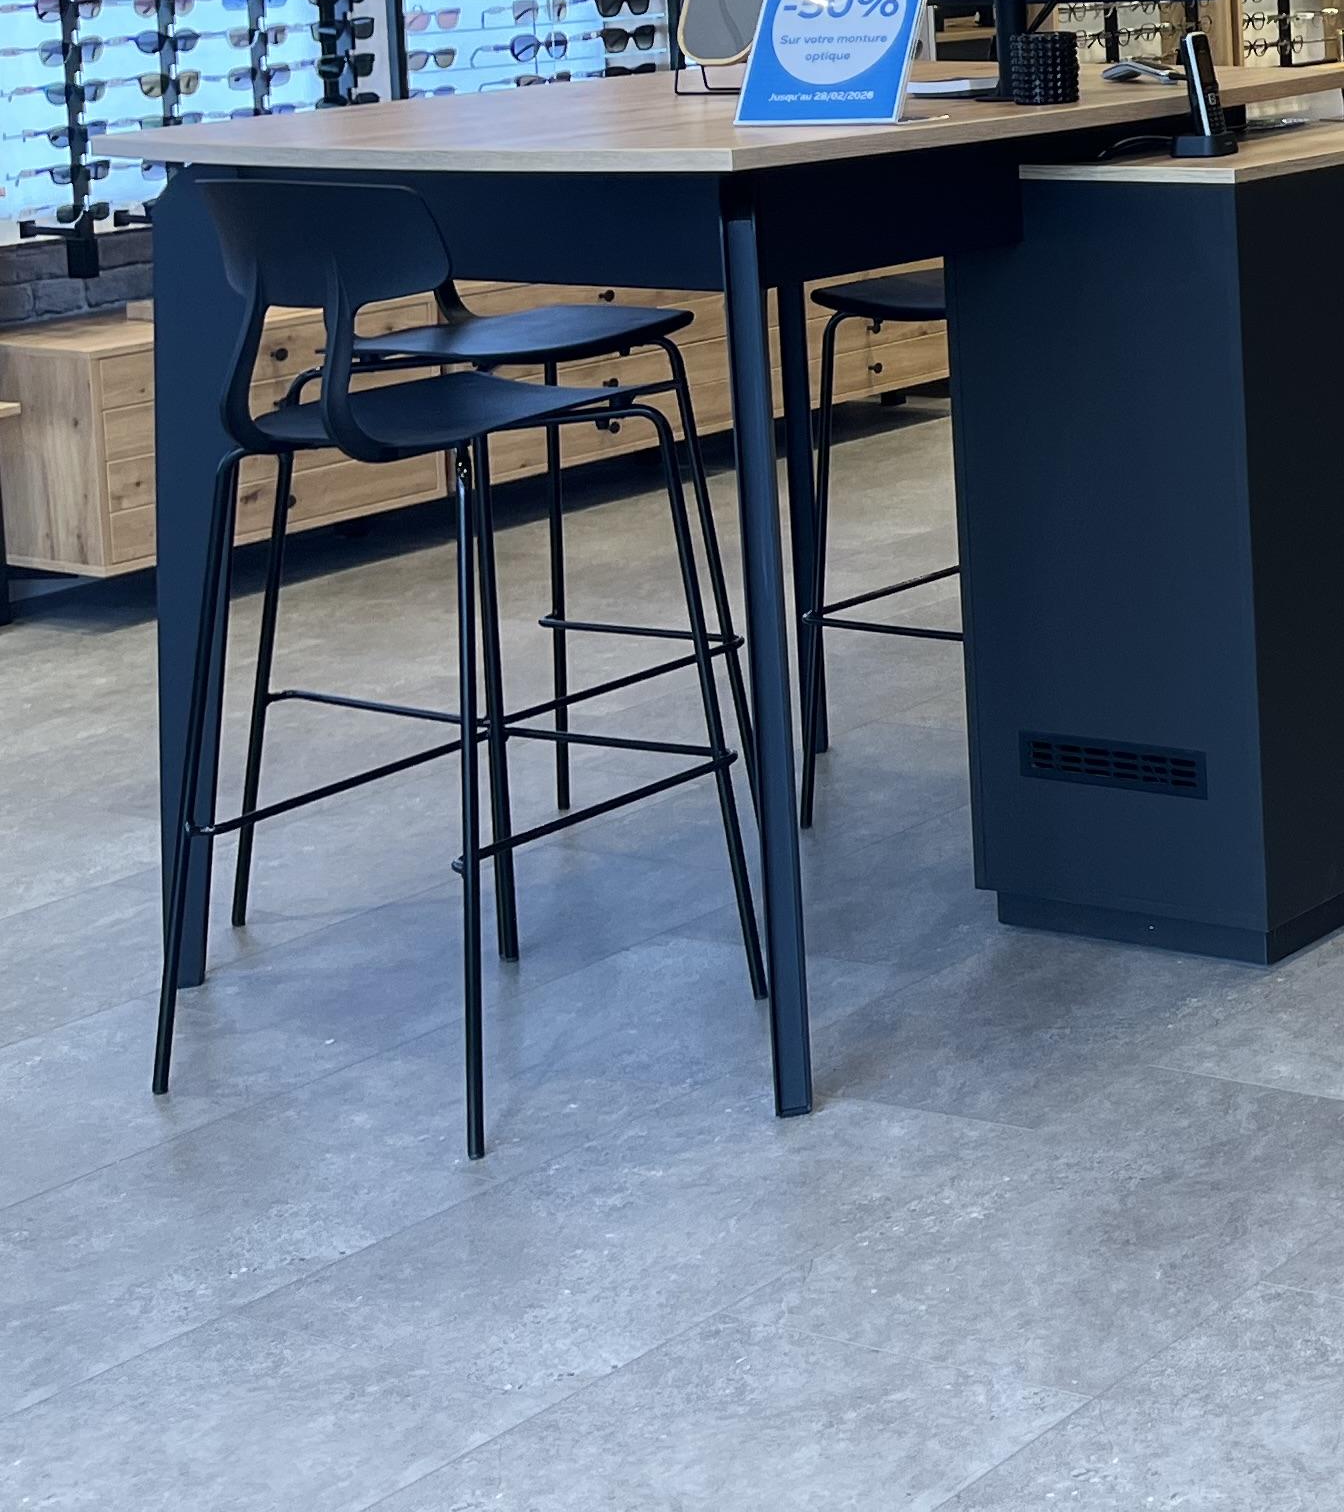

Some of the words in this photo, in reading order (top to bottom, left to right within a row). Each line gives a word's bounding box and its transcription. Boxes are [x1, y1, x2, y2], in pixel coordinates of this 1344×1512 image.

[780, 34, 802, 45] Sur
[804, 34, 835, 44] votre
[837, 34, 888, 44] monture
[805, 51, 851, 63] optique
